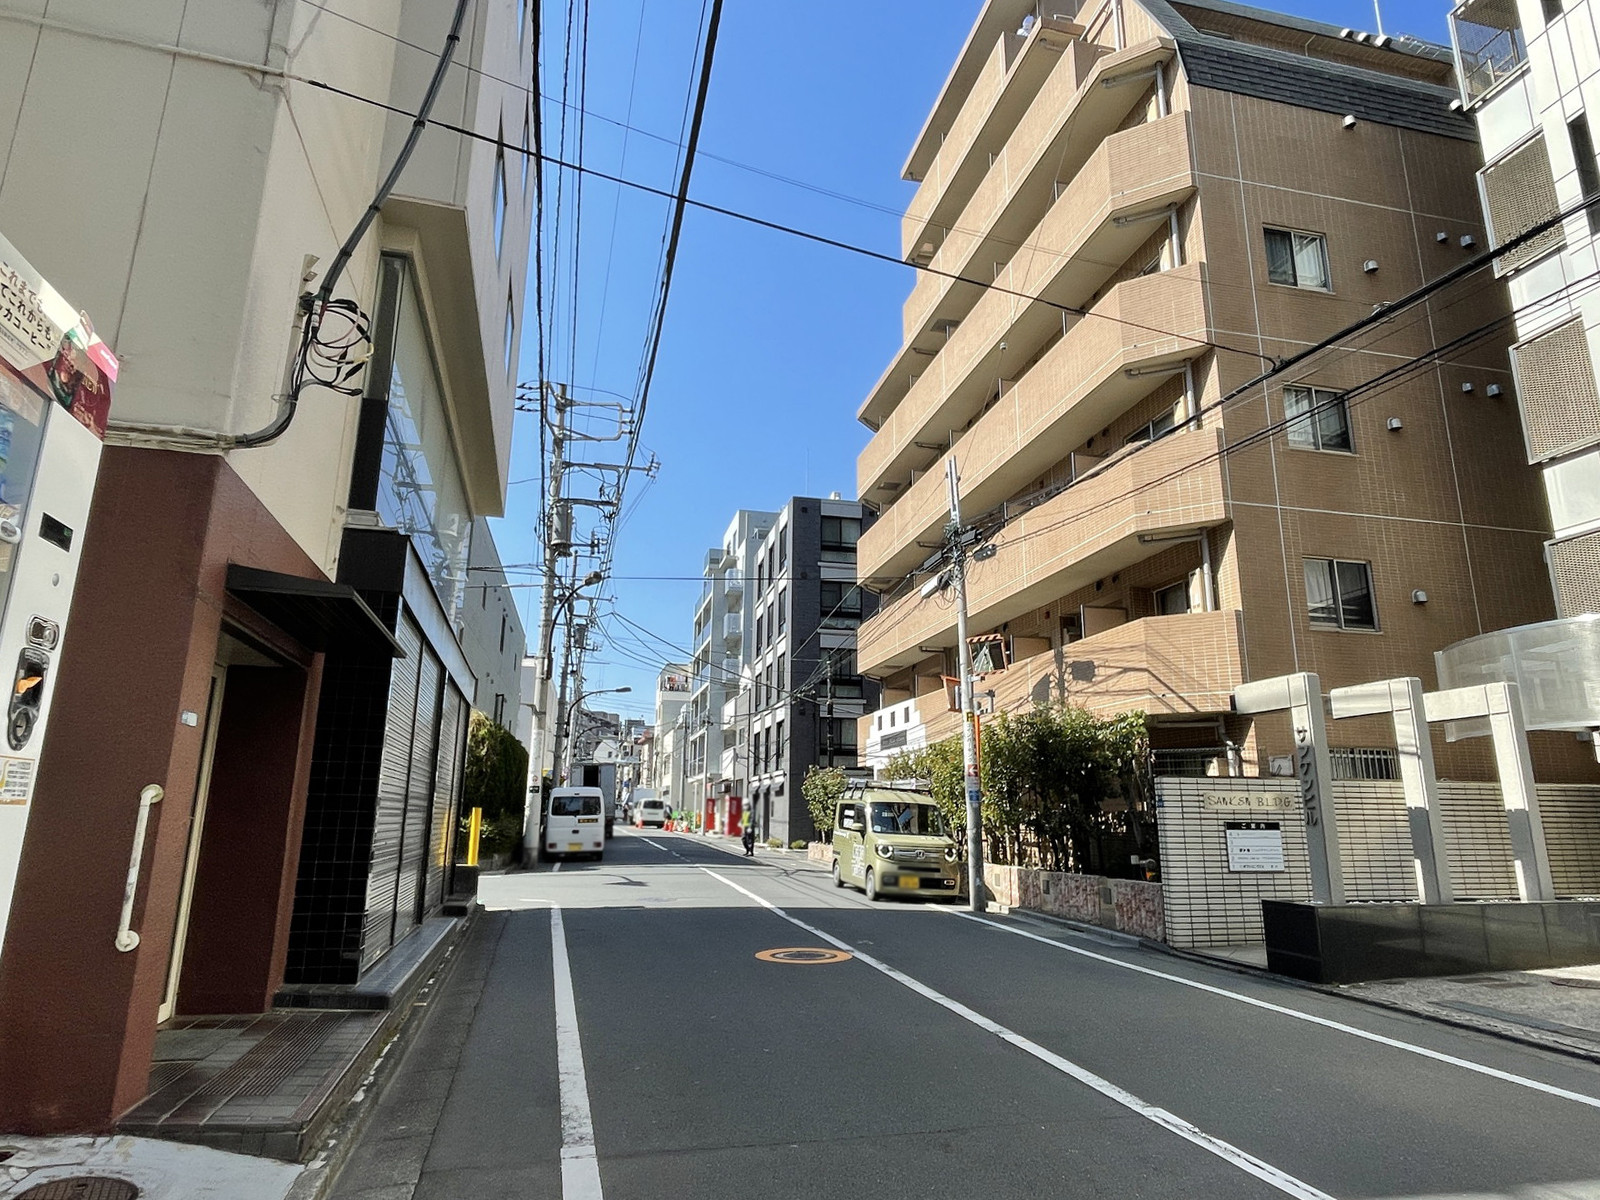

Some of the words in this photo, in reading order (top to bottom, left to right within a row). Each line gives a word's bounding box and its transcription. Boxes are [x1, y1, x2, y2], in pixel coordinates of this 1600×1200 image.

[1295, 726, 1318, 826] サンケンビル
